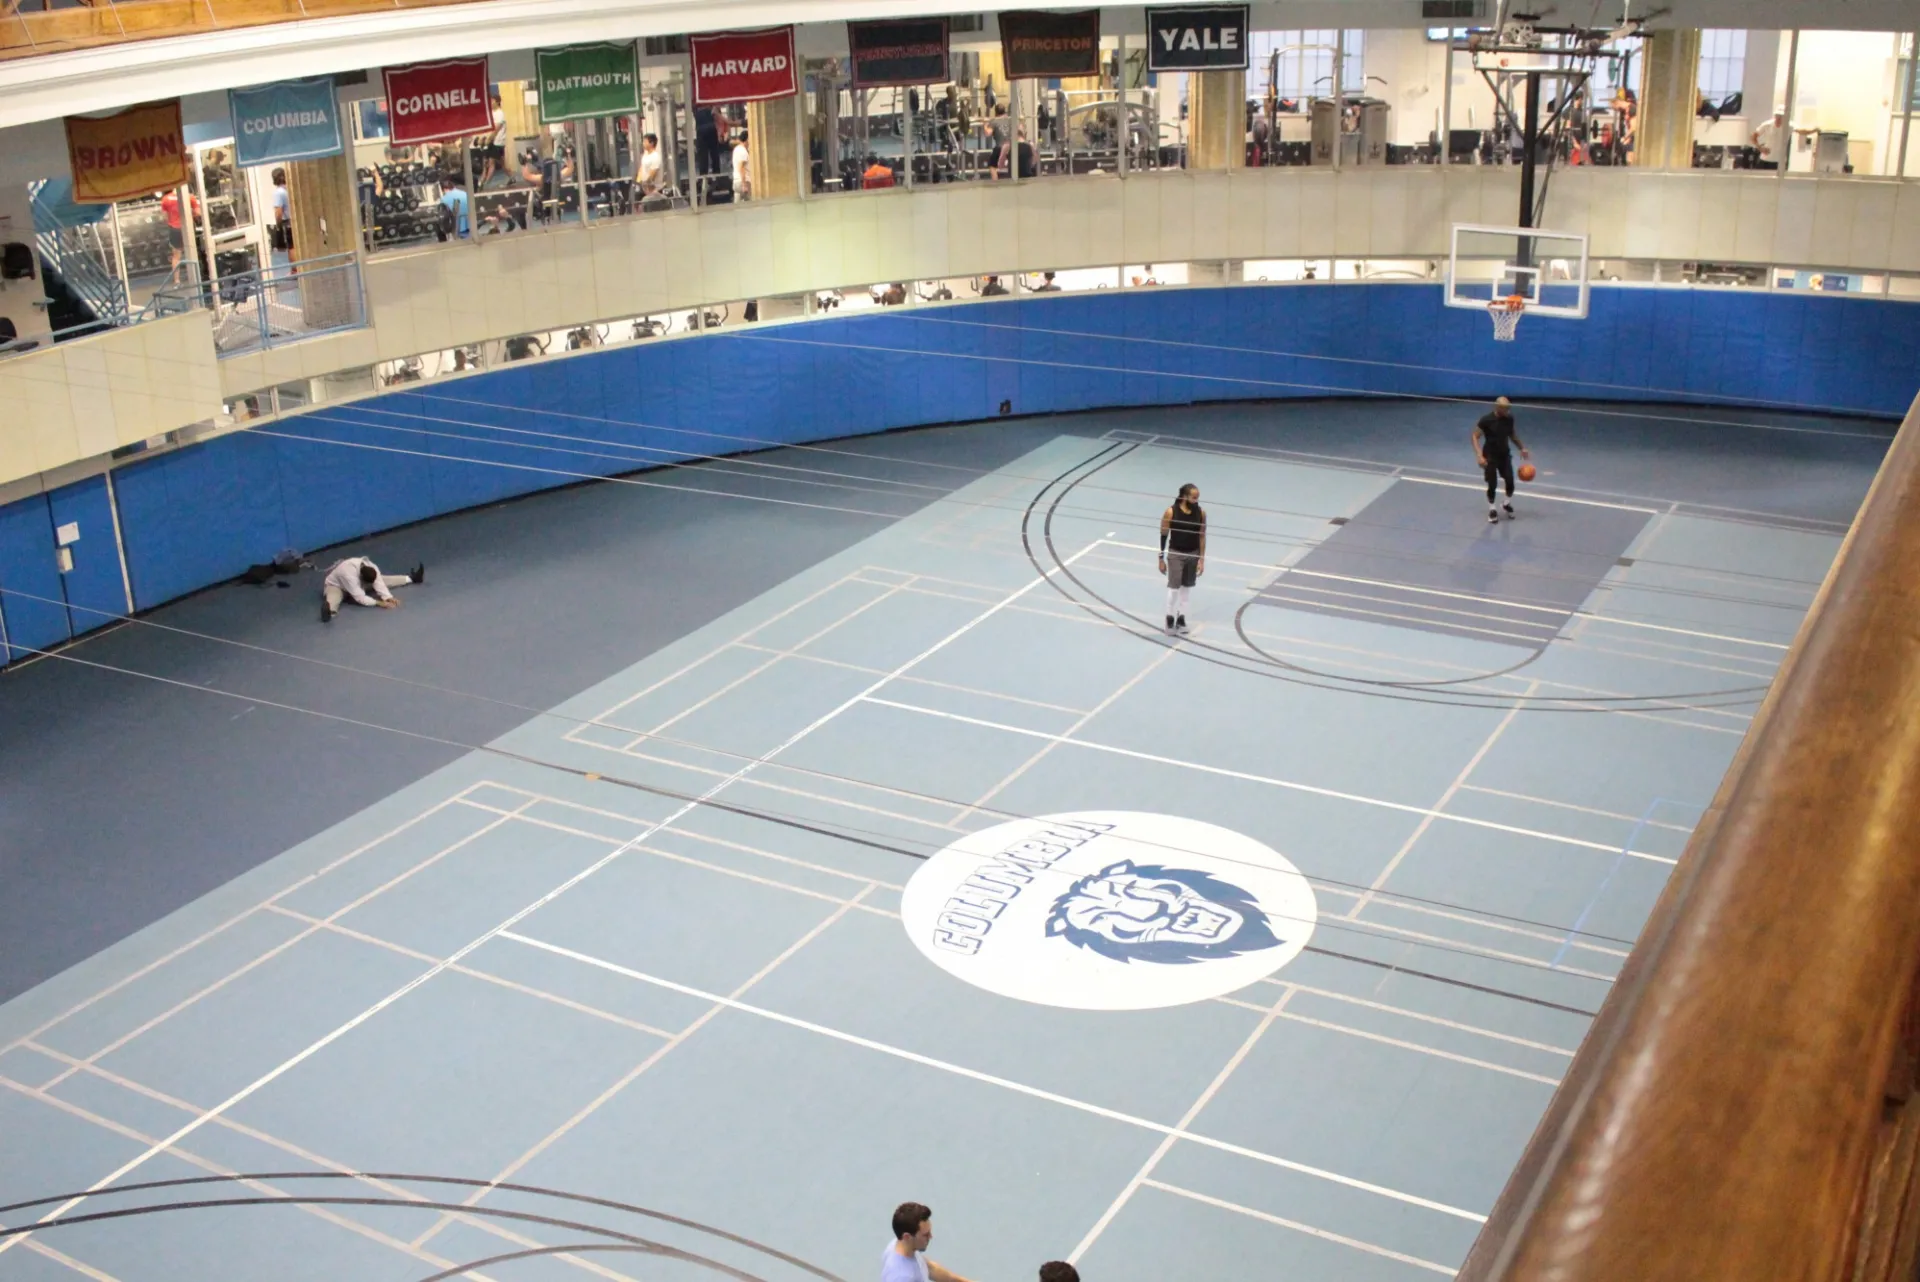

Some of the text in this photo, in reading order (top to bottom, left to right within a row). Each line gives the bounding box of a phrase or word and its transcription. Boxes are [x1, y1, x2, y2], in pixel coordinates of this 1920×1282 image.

[1011, 37, 1092, 52] PRINCETON
[1158, 27, 1238, 51] YALE
[701, 55, 787, 78] HARVARD
[546, 73, 632, 92] DARTMOUTH
[396, 88, 481, 116] CORNELL
[243, 110, 328, 134] COLUMBIA
[77, 133, 177, 171] BROWN
[932, 820, 1118, 956] COLUMBIA
